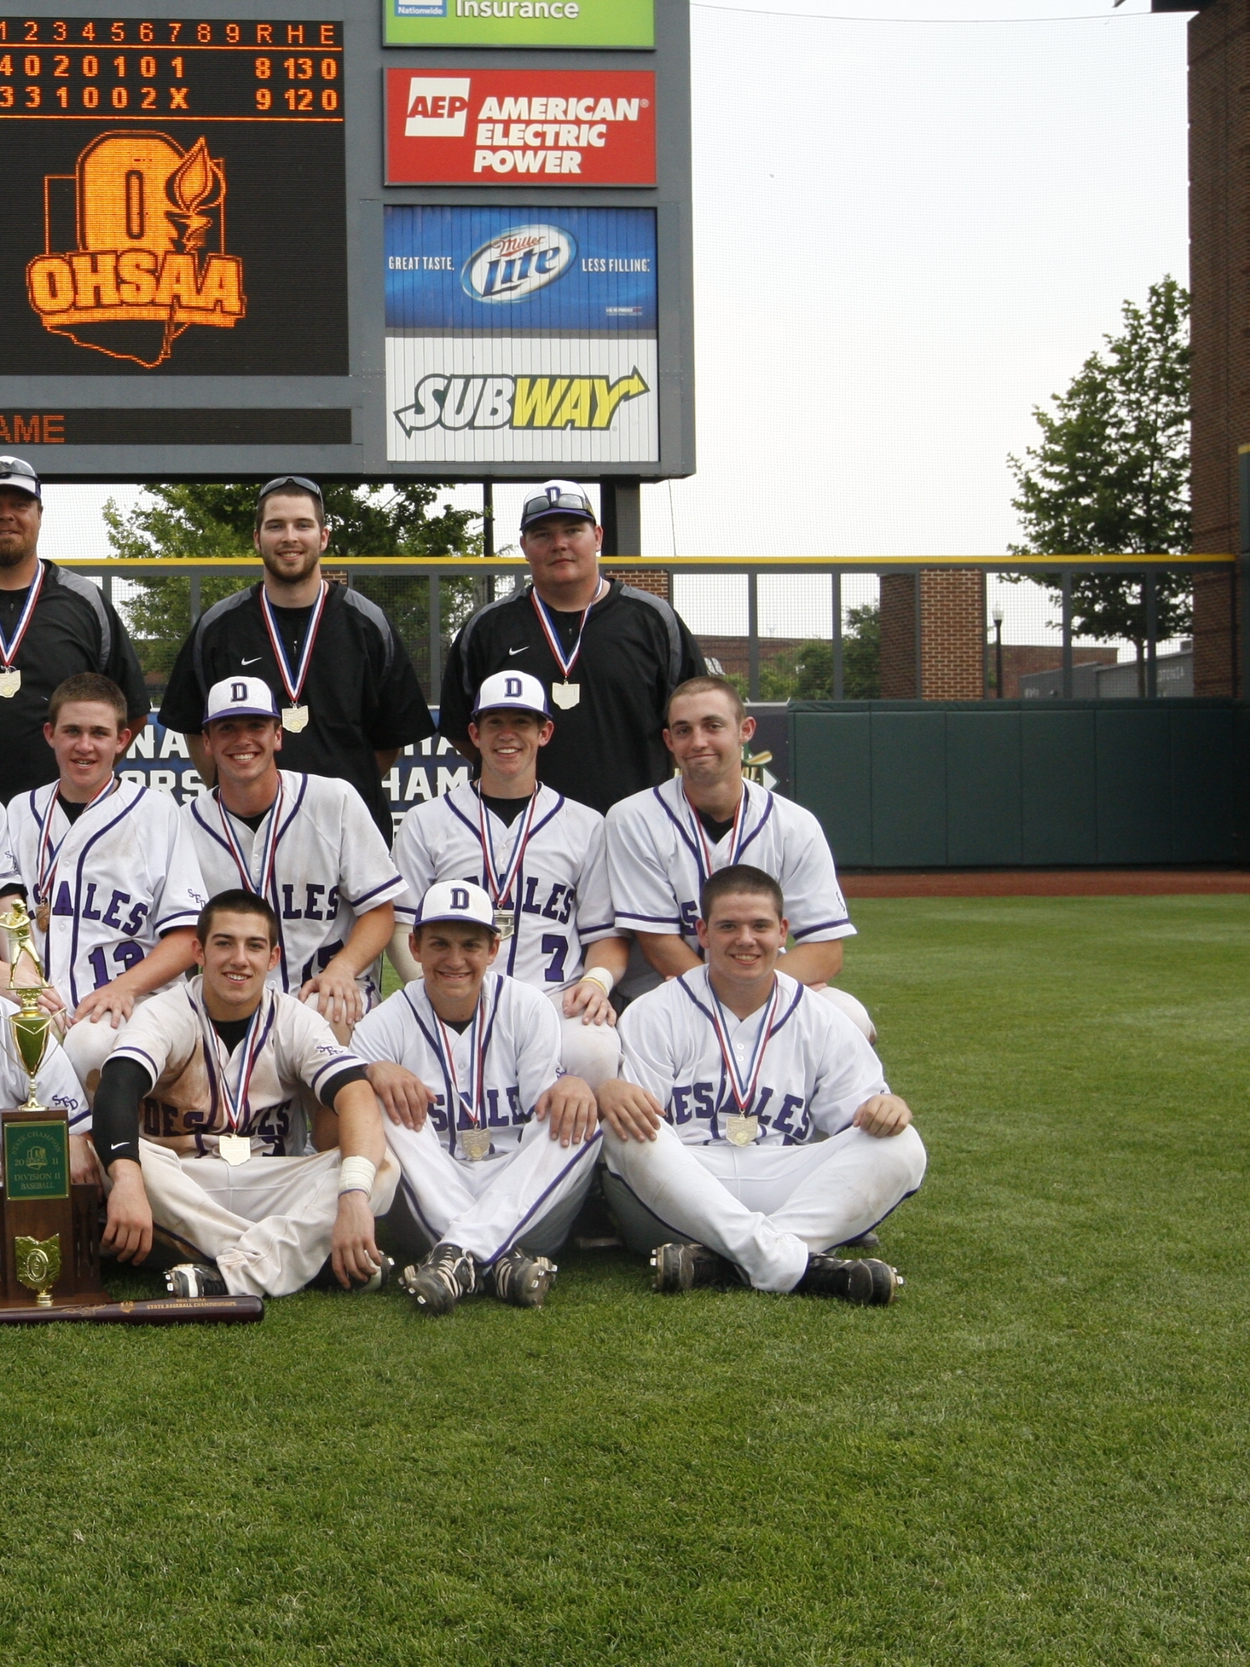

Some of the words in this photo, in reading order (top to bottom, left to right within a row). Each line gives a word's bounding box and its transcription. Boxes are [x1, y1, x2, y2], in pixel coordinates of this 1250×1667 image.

[398, 6, 443, 14] Nationwide
[457, 0, 579, 18] Insurance
[25, 22, 37, 40] 2
[54, 22, 66, 40] 3
[83, 23, 95, 41] 4
[112, 23, 124, 41] 5
[140, 23, 153, 41] 6
[169, 23, 181, 42] 7
[198, 24, 210, 42] 8
[227, 24, 239, 43] 9
[257, 25, 272, 43] R
[288, 25, 303, 44] H
[321, 25, 333, 44] E
[25, 55, 40, 76] 0
[54, 56, 69, 77] 2
[83, 56, 98, 77] 0
[114, 56, 125, 77] 1
[141, 57, 155, 77] 0
[172, 57, 182, 78] 1
[256, 58, 270, 78] 8
[284, 58, 312, 79] 13
[322, 59, 336, 79] 0
[0, 86, 13, 107] 3
[26, 87, 40, 107] 3
[57, 87, 68, 107] 1
[84, 87, 98, 107] 0
[112, 88, 127, 108] 0
[141, 88, 156, 109] 2
[170, 88, 188, 109] X
[256, 89, 271, 110] 9
[285, 89, 312, 110] 12
[322, 90, 337, 110] 0
[407, 96, 470, 119] AEP
[476, 124, 607, 147] ELECTRIC
[473, 150, 582, 174] POWER
[497, 235, 547, 257] Miller
[388, 256, 420, 270] GREAT
[422, 256, 455, 271] TASTE.
[481, 246, 561, 298] Lite
[582, 258, 606, 272] LESS
[27, 249, 246, 317] OHSAA
[393, 364, 651, 440] SUBWAY
[231, 682, 248, 702] D
[505, 677, 523, 698] D
[450, 887, 470, 910] D
[541, 933, 569, 982] 7
[14, 1172, 52, 1182] DIVISION
